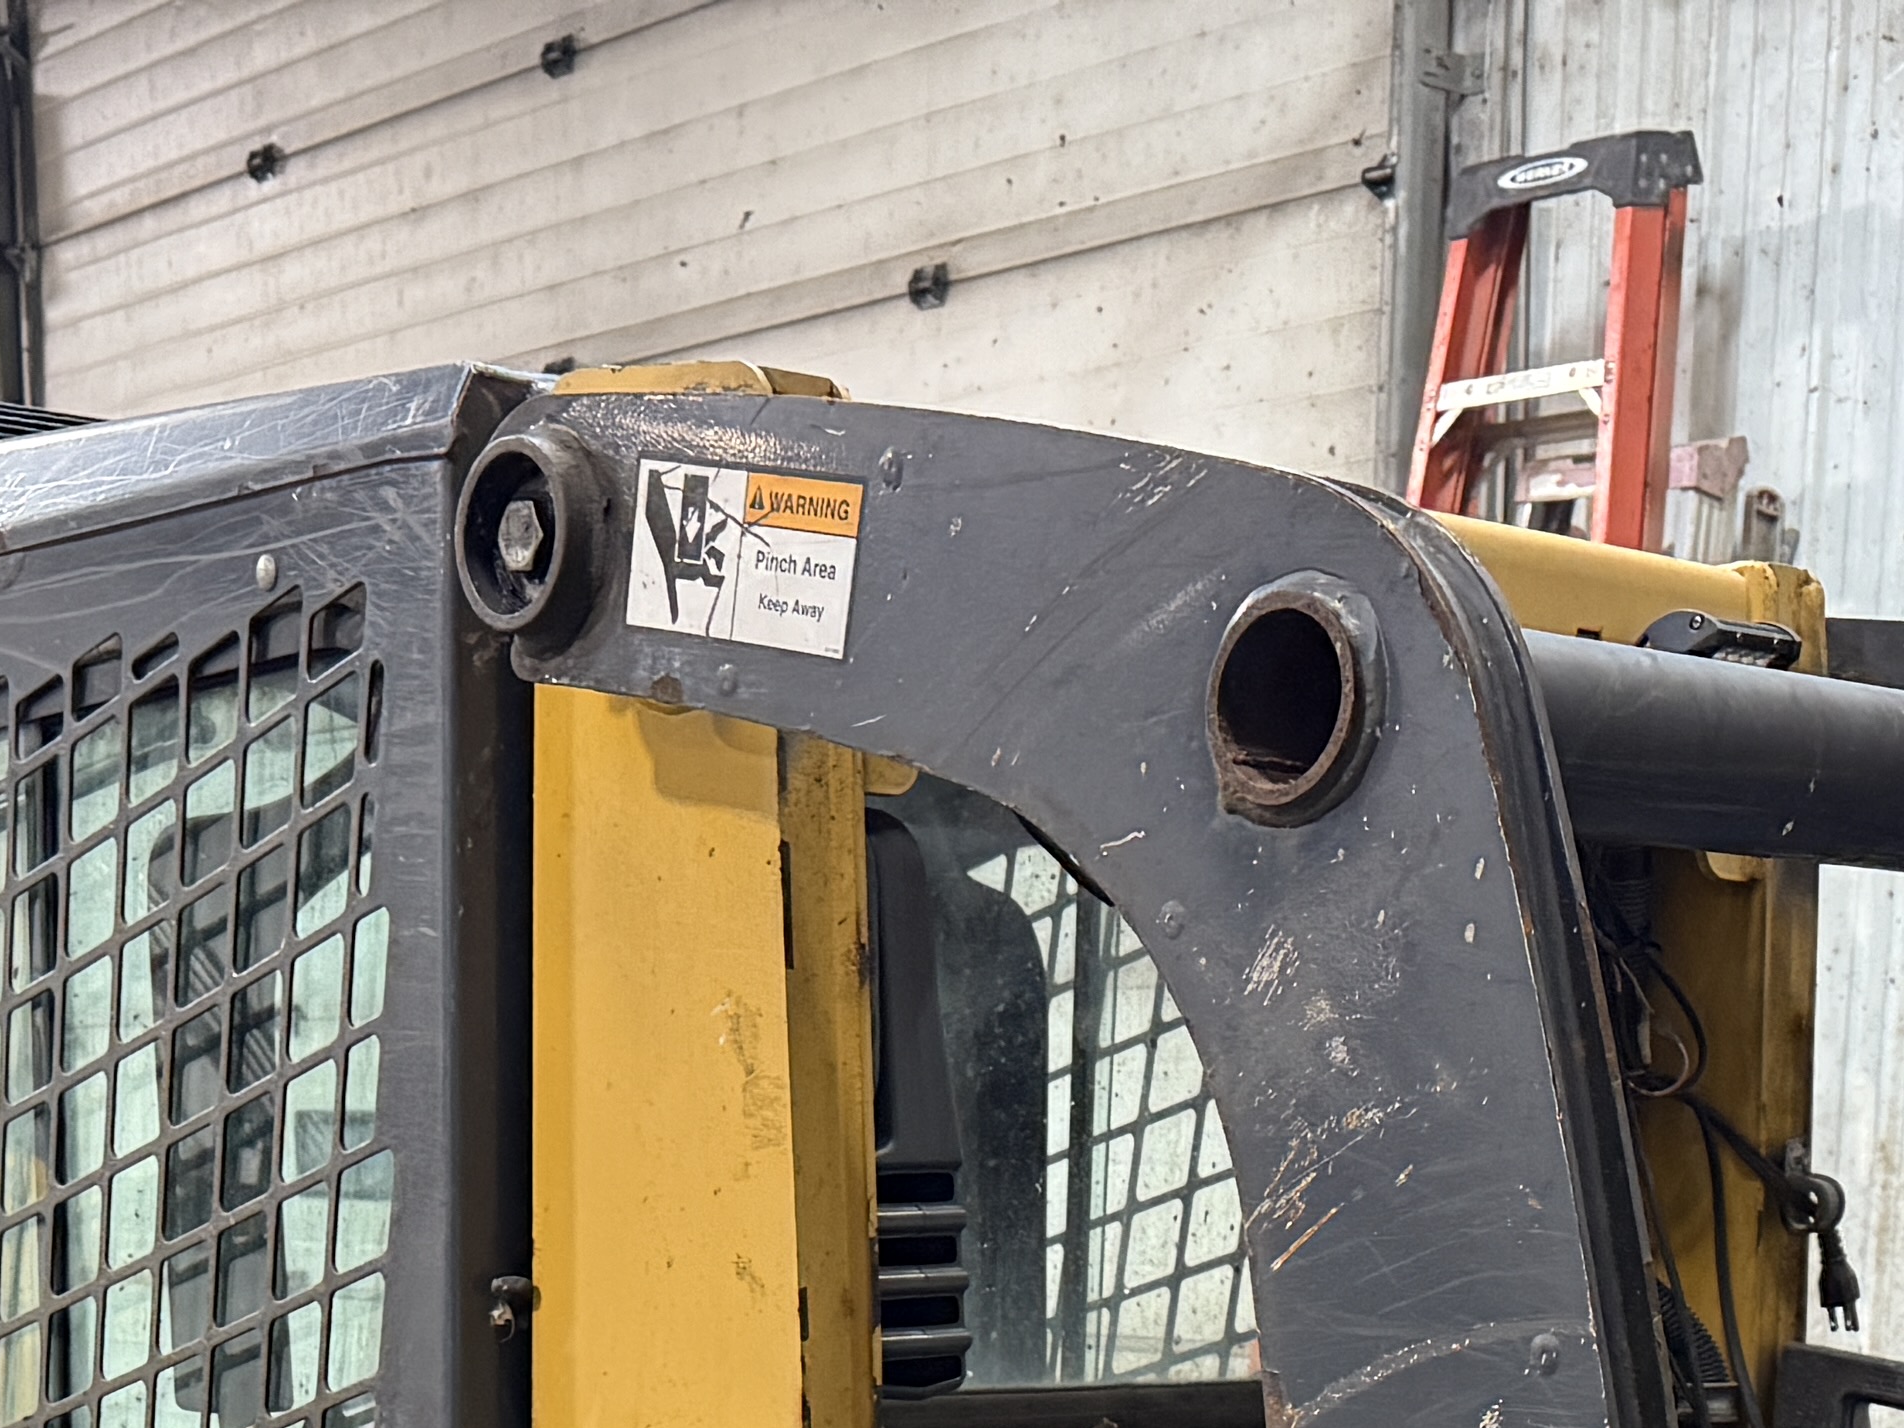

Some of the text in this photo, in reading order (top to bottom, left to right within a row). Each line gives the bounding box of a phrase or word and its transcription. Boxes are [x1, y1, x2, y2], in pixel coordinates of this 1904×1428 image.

[769, 490, 851, 522] WARNING
[755, 550, 837, 580] Pinch Area
[758, 593, 825, 622] Keep Away
